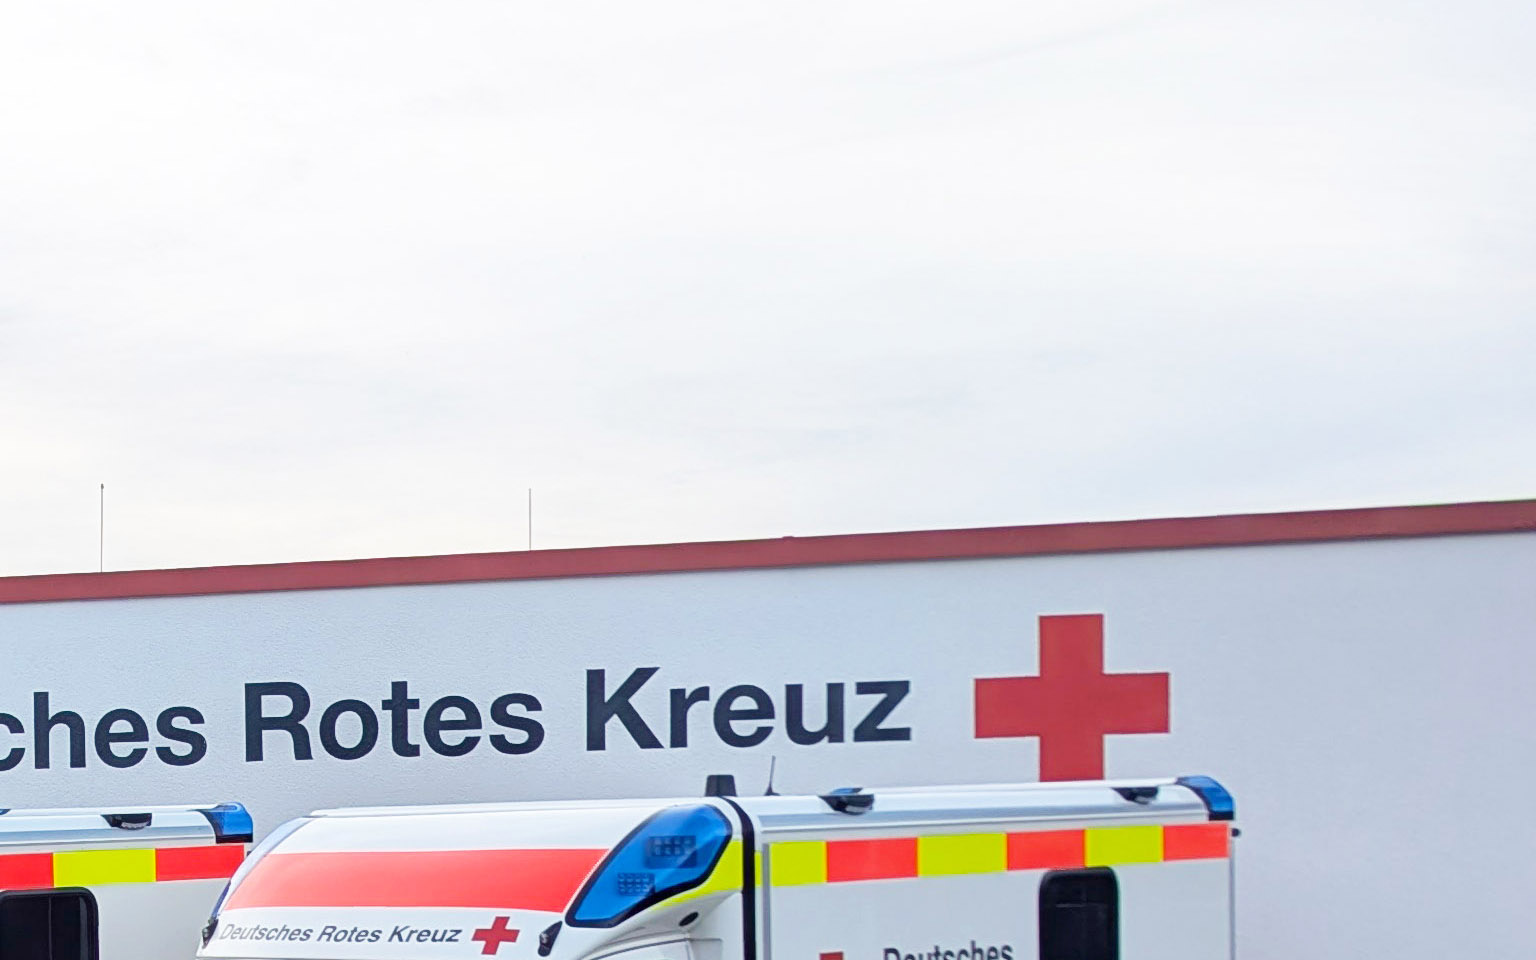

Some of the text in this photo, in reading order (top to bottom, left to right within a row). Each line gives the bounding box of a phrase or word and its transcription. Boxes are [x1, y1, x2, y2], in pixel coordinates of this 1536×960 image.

[244, 681, 545, 762] Rotes
[585, 667, 911, 751] Kreuz
[219, 924, 463, 943] Deutsches Rotes Kreuz
